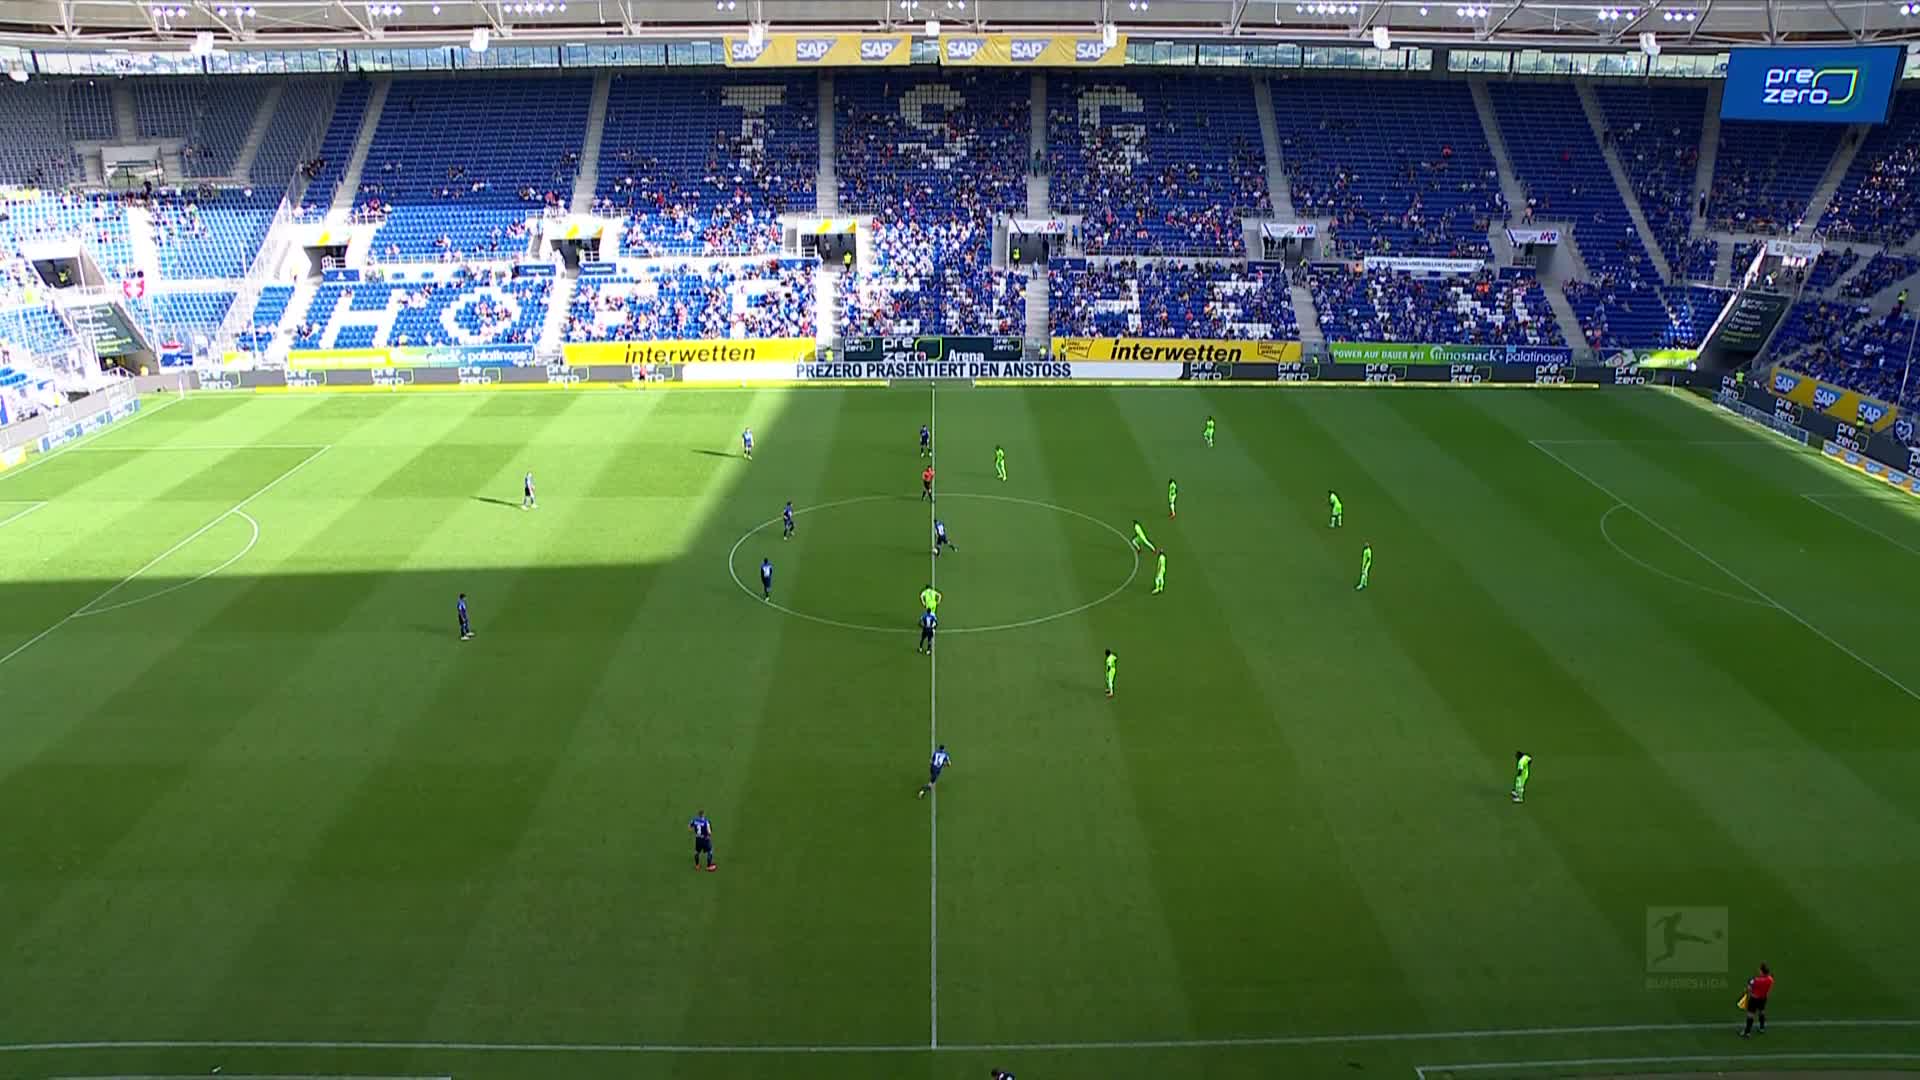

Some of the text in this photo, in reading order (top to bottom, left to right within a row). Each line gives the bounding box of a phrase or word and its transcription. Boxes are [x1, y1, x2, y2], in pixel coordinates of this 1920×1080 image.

[796, 42, 829, 59] SAP
[861, 42, 893, 59] SAP
[947, 41, 979, 59] SAP
[1011, 41, 1043, 59] SAP
[1076, 41, 1107, 58] SAP
[1765, 68, 1815, 88] pre
[1763, 88, 1829, 104] zero
[882, 336, 915, 350] pre
[1110, 339, 1242, 361] interwetten
[625, 343, 756, 364] interwetten
[882, 351, 927, 362] zero
[948, 350, 985, 362] Arena
[796, 360, 1072, 379] PREZERO PRÄSENTIERT DEN ANSTOSS
[1190, 361, 1214, 372] pre
[1278, 361, 1302, 372] pre
[1365, 362, 1389, 373] pre
[1450, 364, 1474, 375] pre
[1535, 364, 1559, 375] pre
[1615, 366, 1639, 376] pre
[1189, 371, 1222, 381] zero
[1278, 371, 1310, 381] zero
[1365, 373, 1396, 383] zero
[1450, 374, 1482, 383] zero
[1535, 375, 1566, 384] zero
[1615, 375, 1645, 385] zero
[1774, 375, 1796, 392] SAP
[1775, 397, 1793, 411] pre
[1814, 388, 1837, 407] SAP
[1773, 409, 1796, 424] zero
[1858, 402, 1882, 422] SAP
[1836, 422, 1857, 438] pre
[1835, 435, 1860, 452] zero
